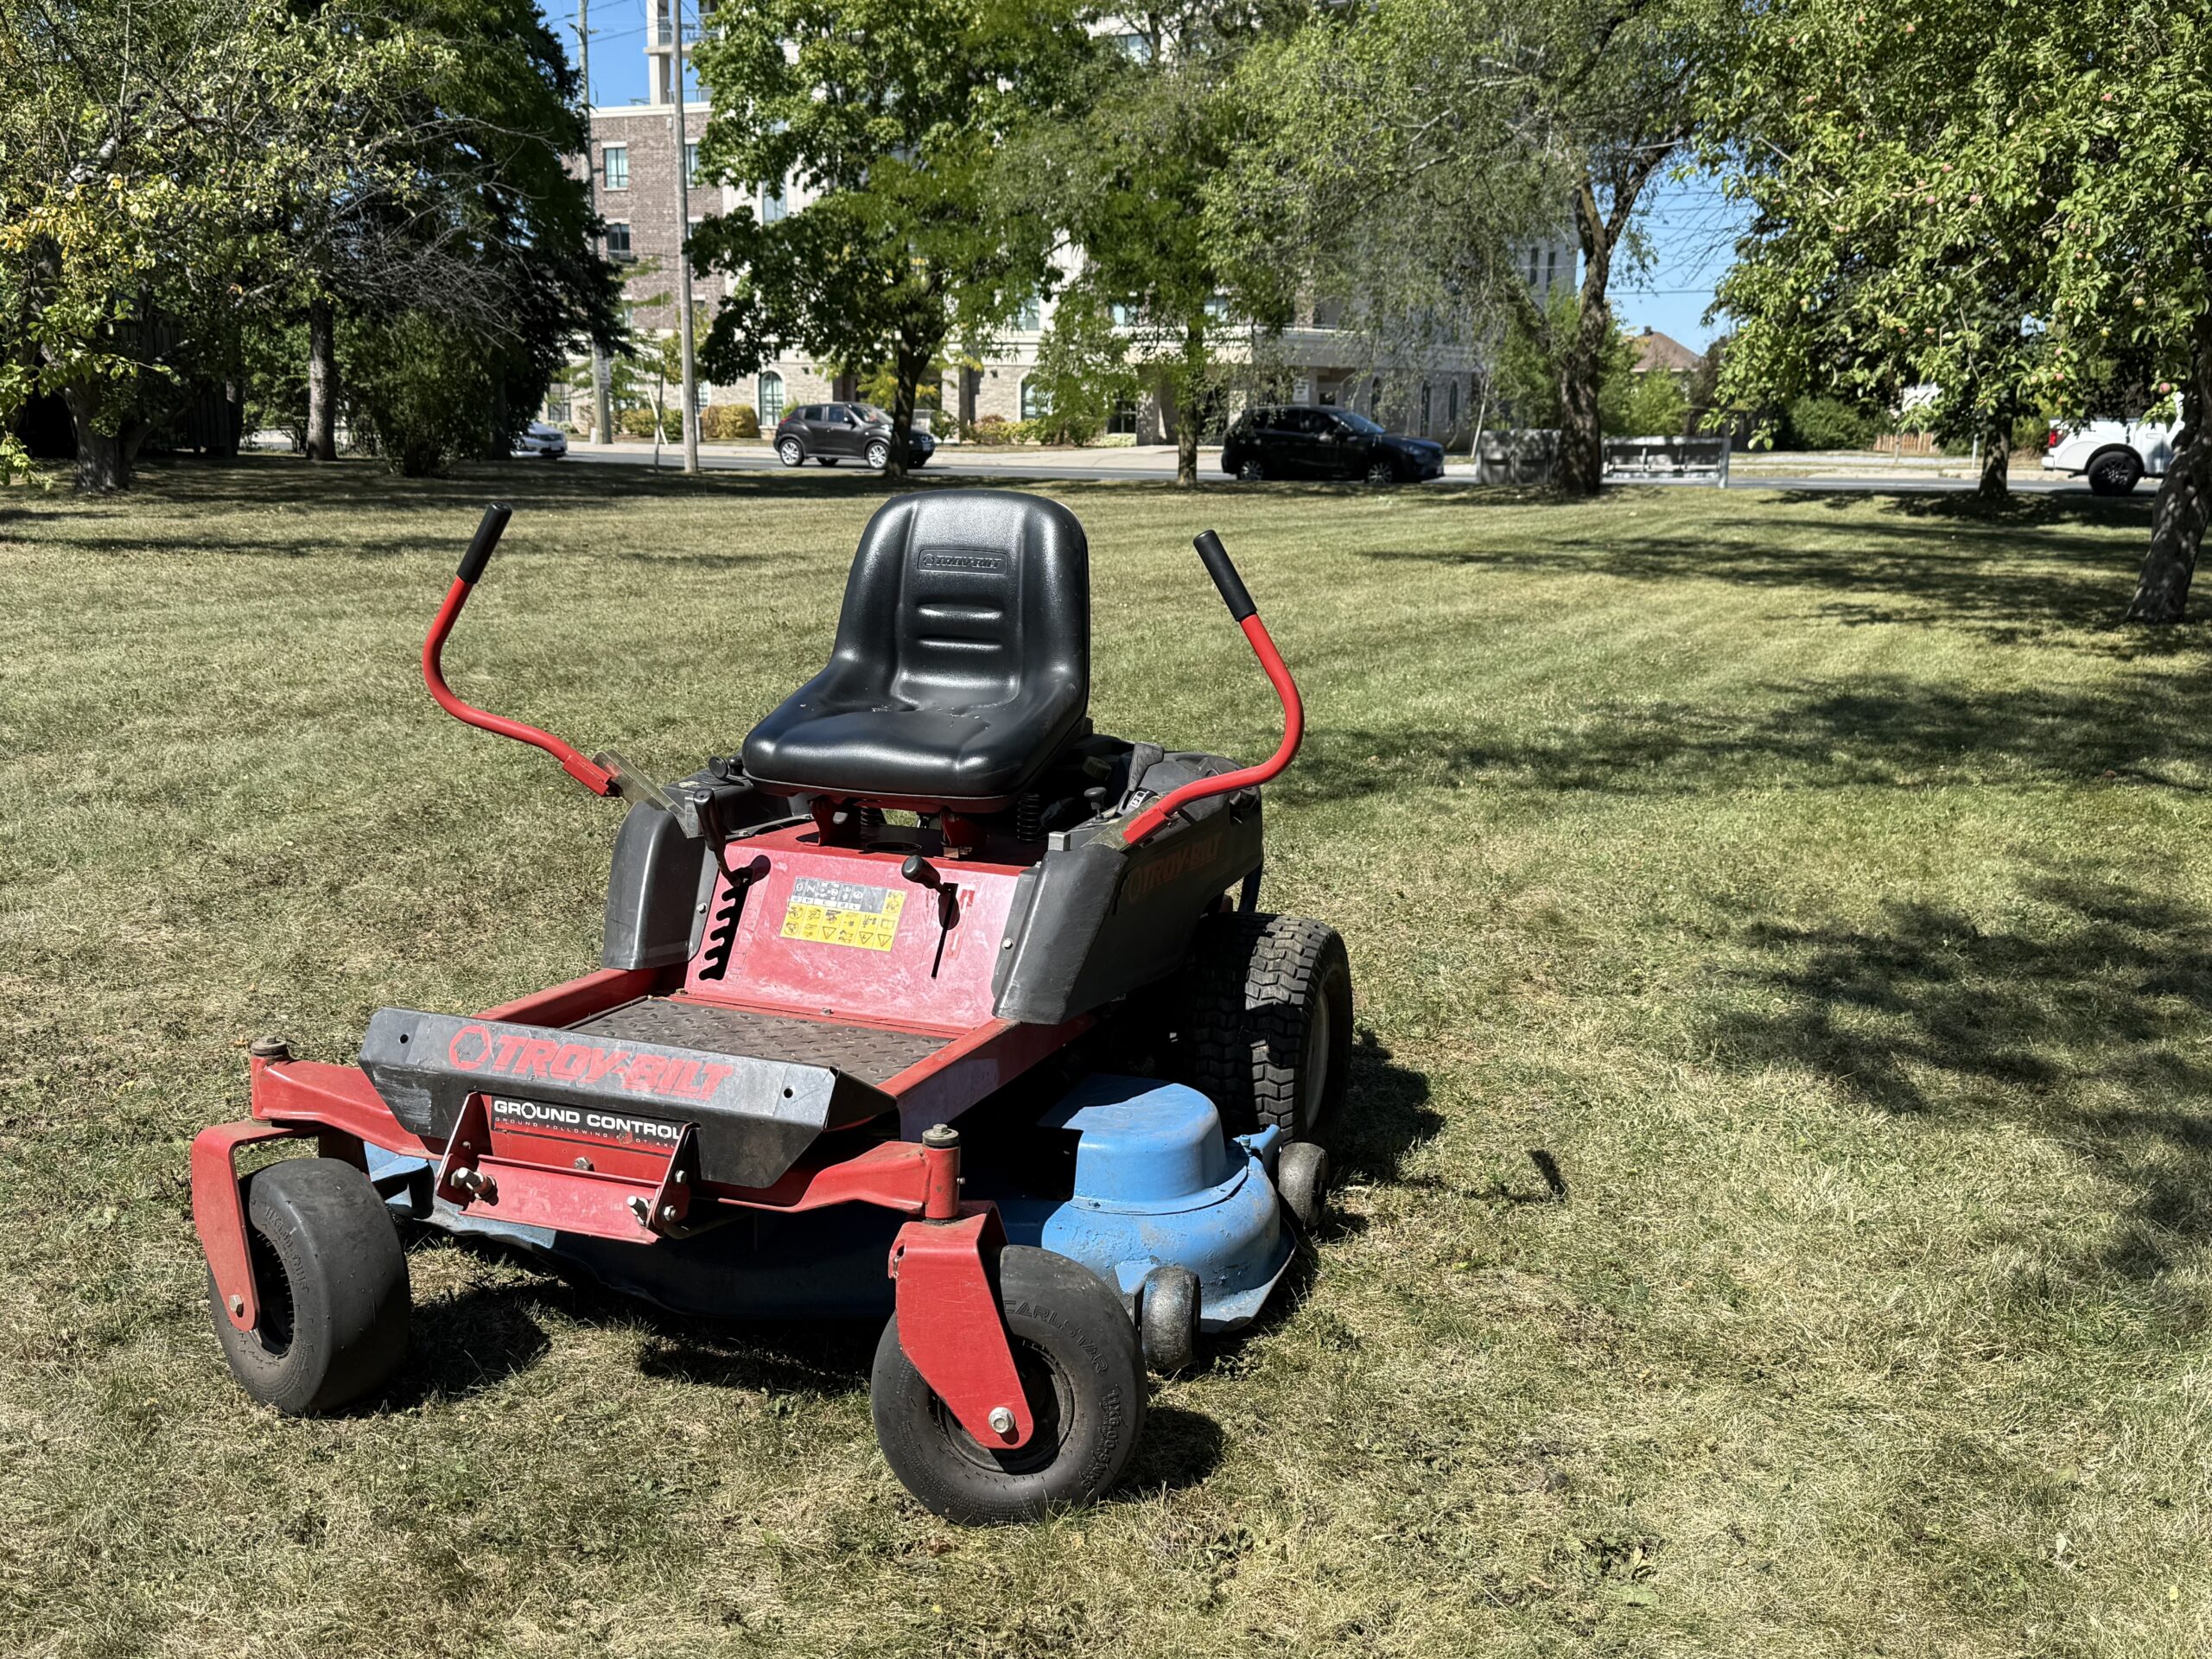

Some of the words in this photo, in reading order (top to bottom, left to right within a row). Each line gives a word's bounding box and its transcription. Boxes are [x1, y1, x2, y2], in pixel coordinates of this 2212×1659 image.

[492, 1034, 734, 1101] TROY-BILT
[493, 1100, 580, 1123] GROUND
[586, 1114, 681, 1140] CONTROL
[494, 1116, 538, 1128] GROUND
[545, 1123, 608, 1138] FOLLOWING
